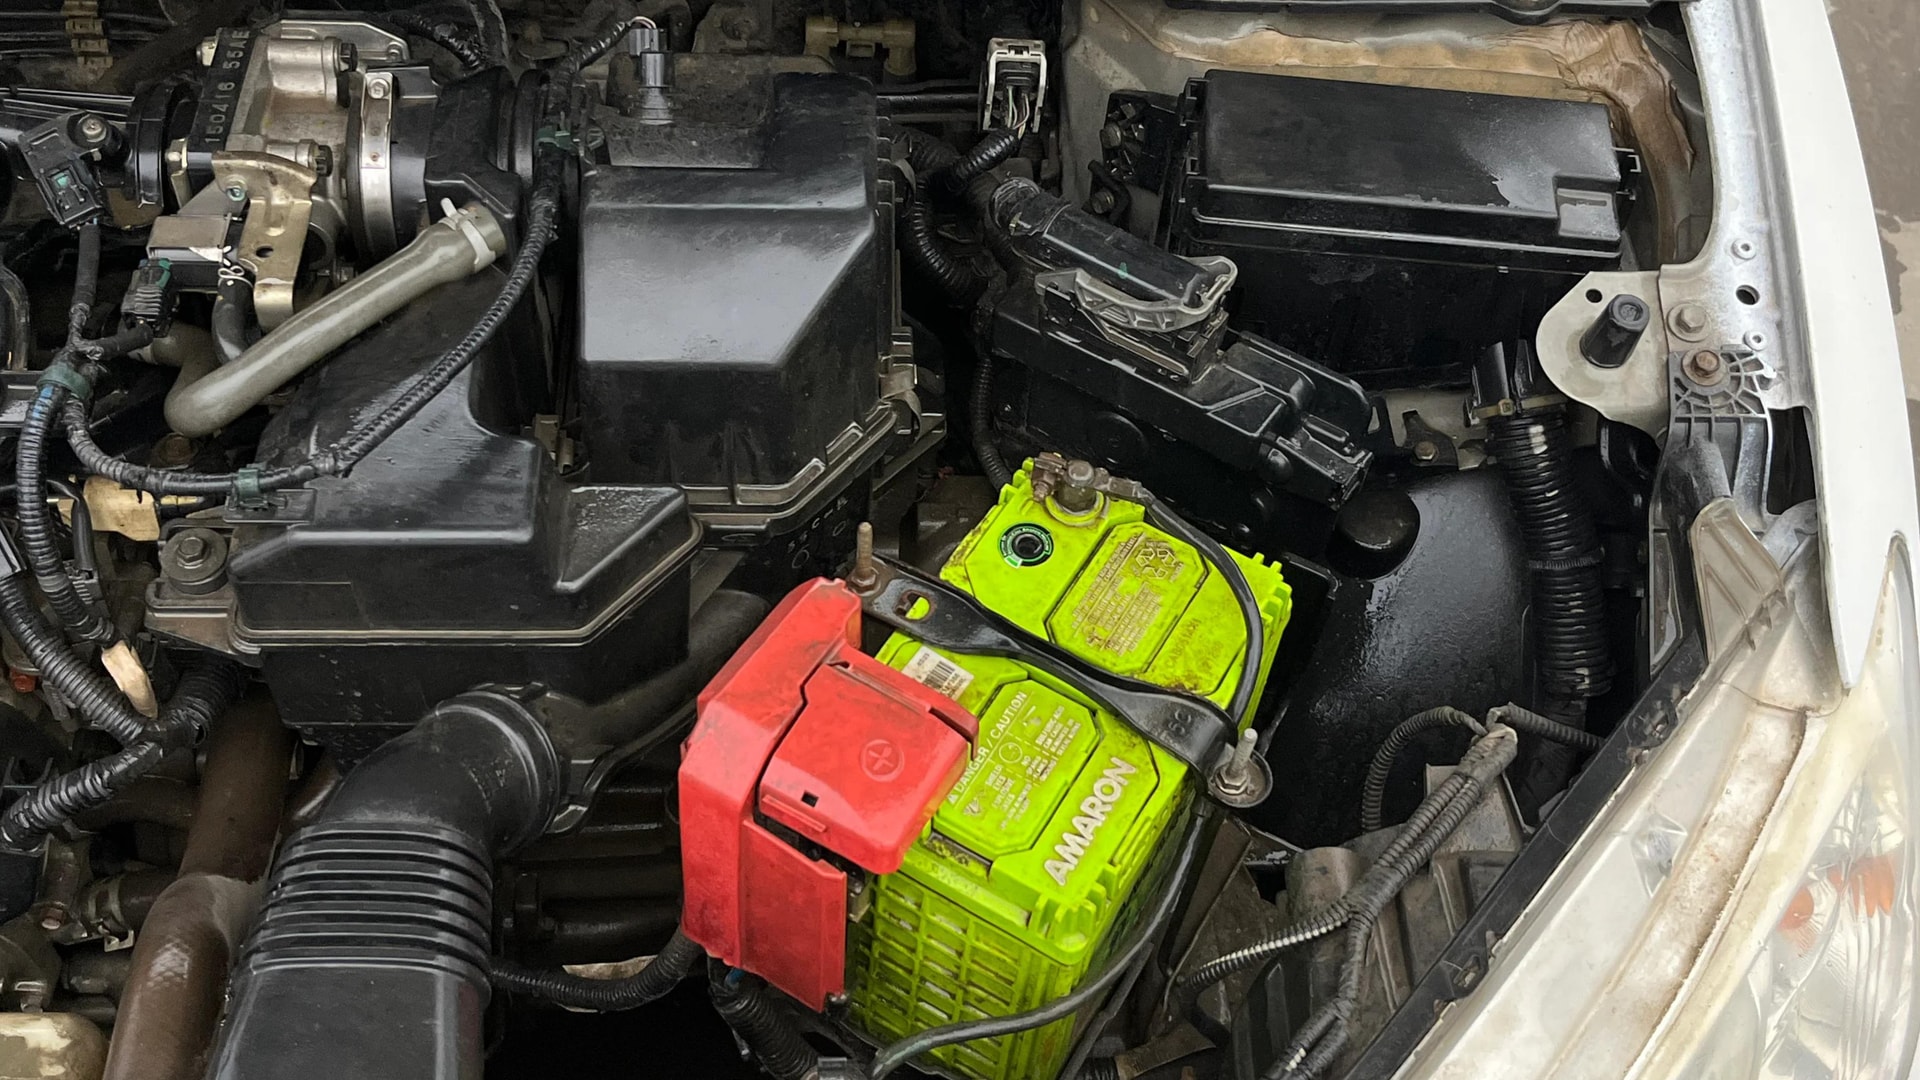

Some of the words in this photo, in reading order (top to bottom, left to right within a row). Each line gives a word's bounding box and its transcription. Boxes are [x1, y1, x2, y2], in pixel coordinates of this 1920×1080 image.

[958, 746, 989, 793] DANGER
[990, 691, 1028, 739] CAUTION
[1044, 756, 1137, 886] AMARON
